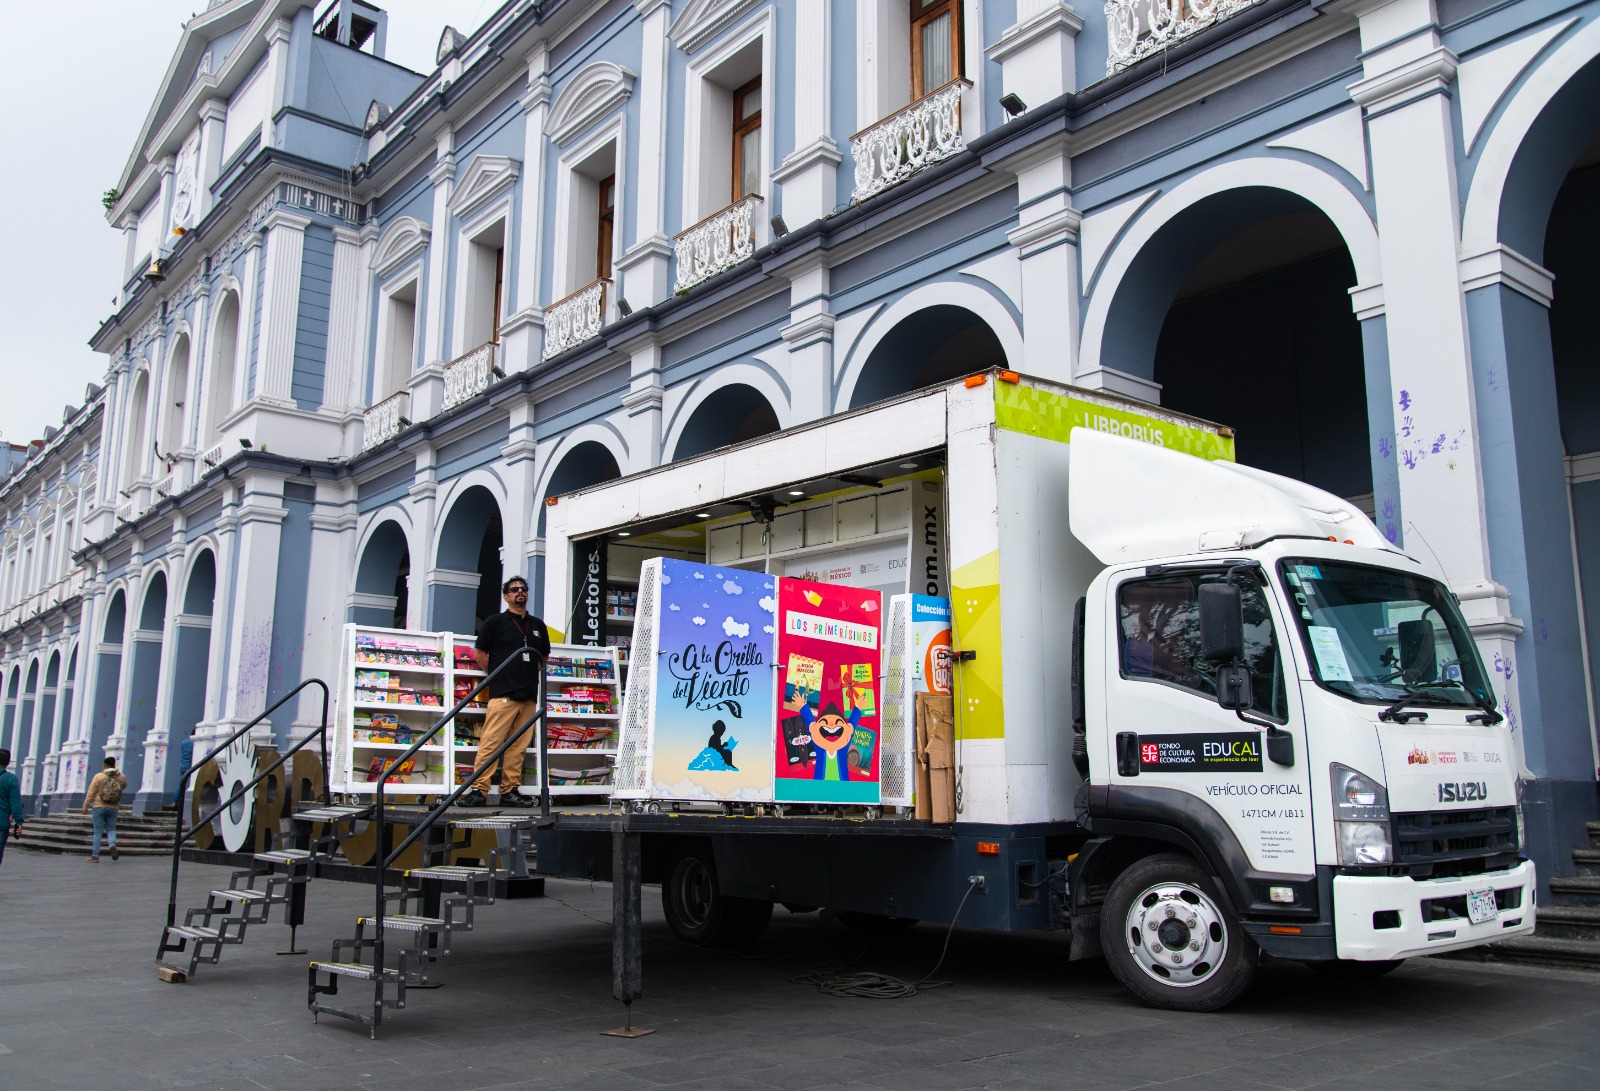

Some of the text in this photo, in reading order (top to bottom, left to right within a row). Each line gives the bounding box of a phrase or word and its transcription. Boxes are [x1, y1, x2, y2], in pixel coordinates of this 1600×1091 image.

[829, 571, 852, 581] MÉXICO
[916, 603, 946, 616] Colección
[791, 618, 808, 632] LOS
[701, 645, 712, 663] la
[714, 640, 764, 675] Orilla
[672, 668, 750, 709] del Viento
[1203, 742, 1259, 757] EDUCAL
[383, 760, 414, 773] BP!
[1159, 756, 1196, 764] ECONÓMICA
[1205, 782, 1303, 796] VEHÍCULO OFICIAL
[1437, 782, 1487, 803] ISUZU
[1241, 809, 1277, 818] 1471CM
